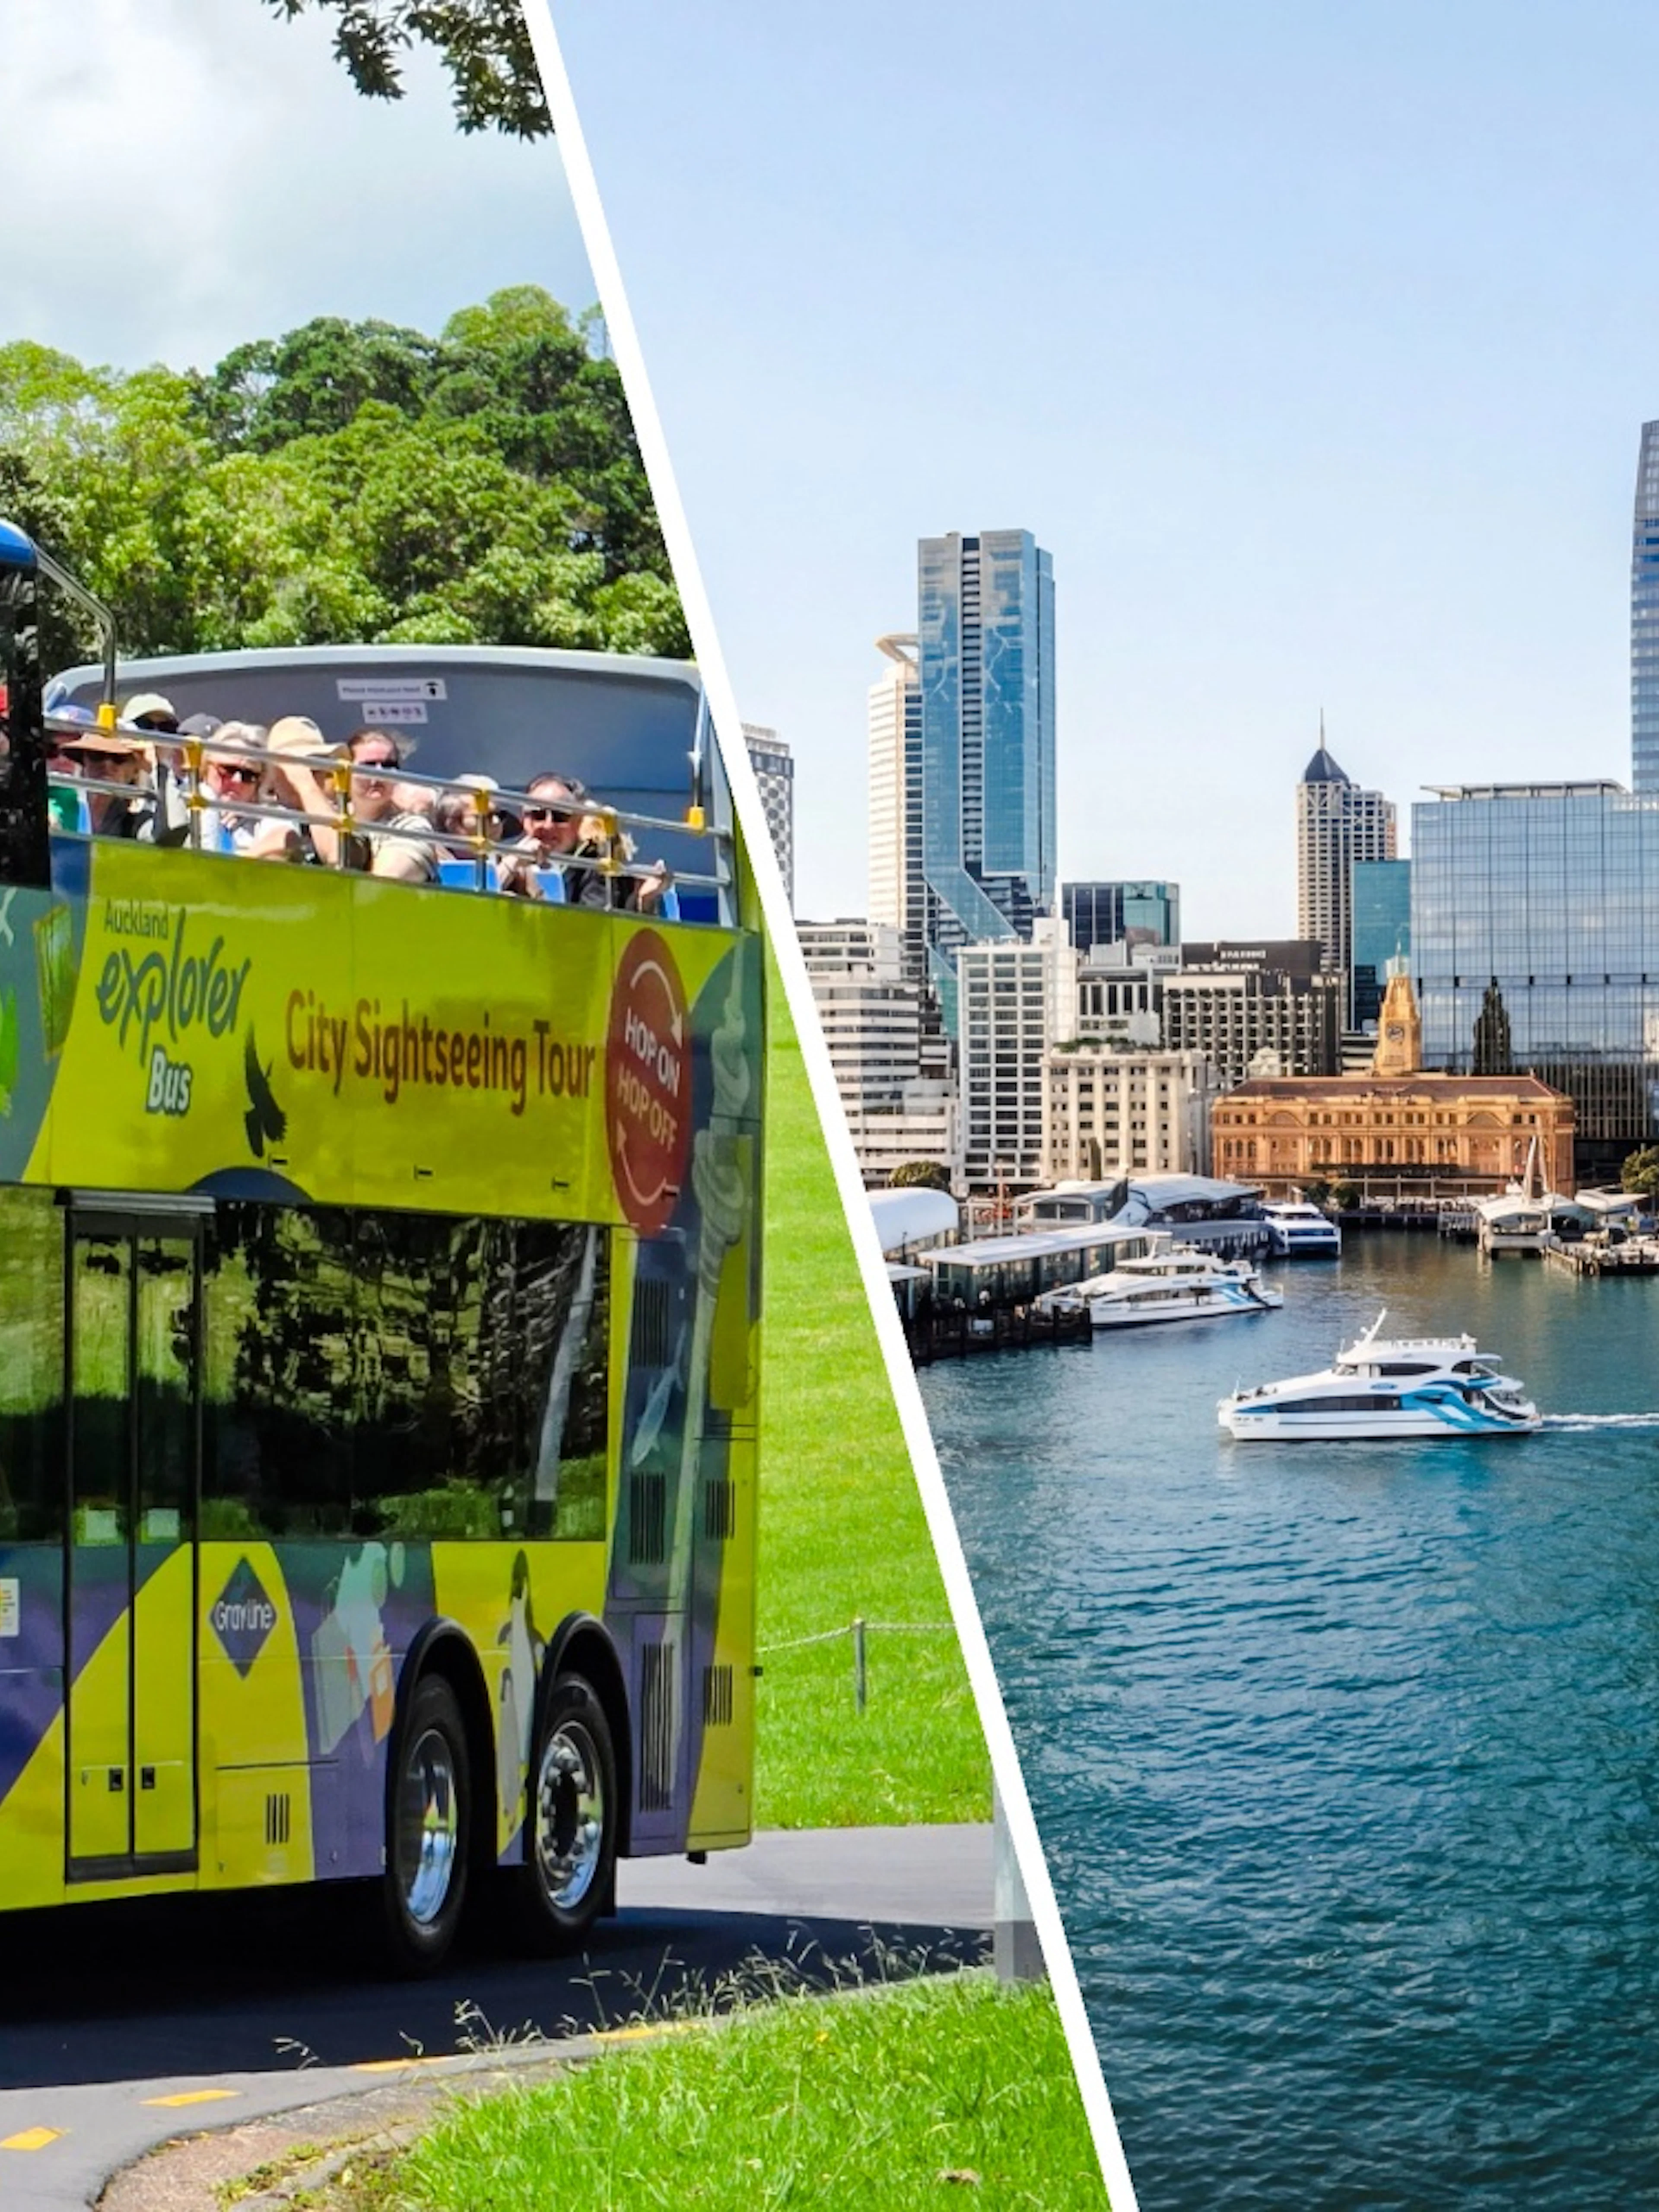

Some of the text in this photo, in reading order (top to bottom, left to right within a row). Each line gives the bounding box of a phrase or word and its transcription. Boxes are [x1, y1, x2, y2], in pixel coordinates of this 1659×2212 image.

[105, 899, 168, 939] Auckland
[95, 907, 251, 1068] explorer
[146, 1044, 193, 1117] Bus
[286, 989, 595, 1116] City Sightseeing Tour
[625, 1005, 680, 1098] HOP ON
[617, 1062, 677, 1152] HOP OFF
